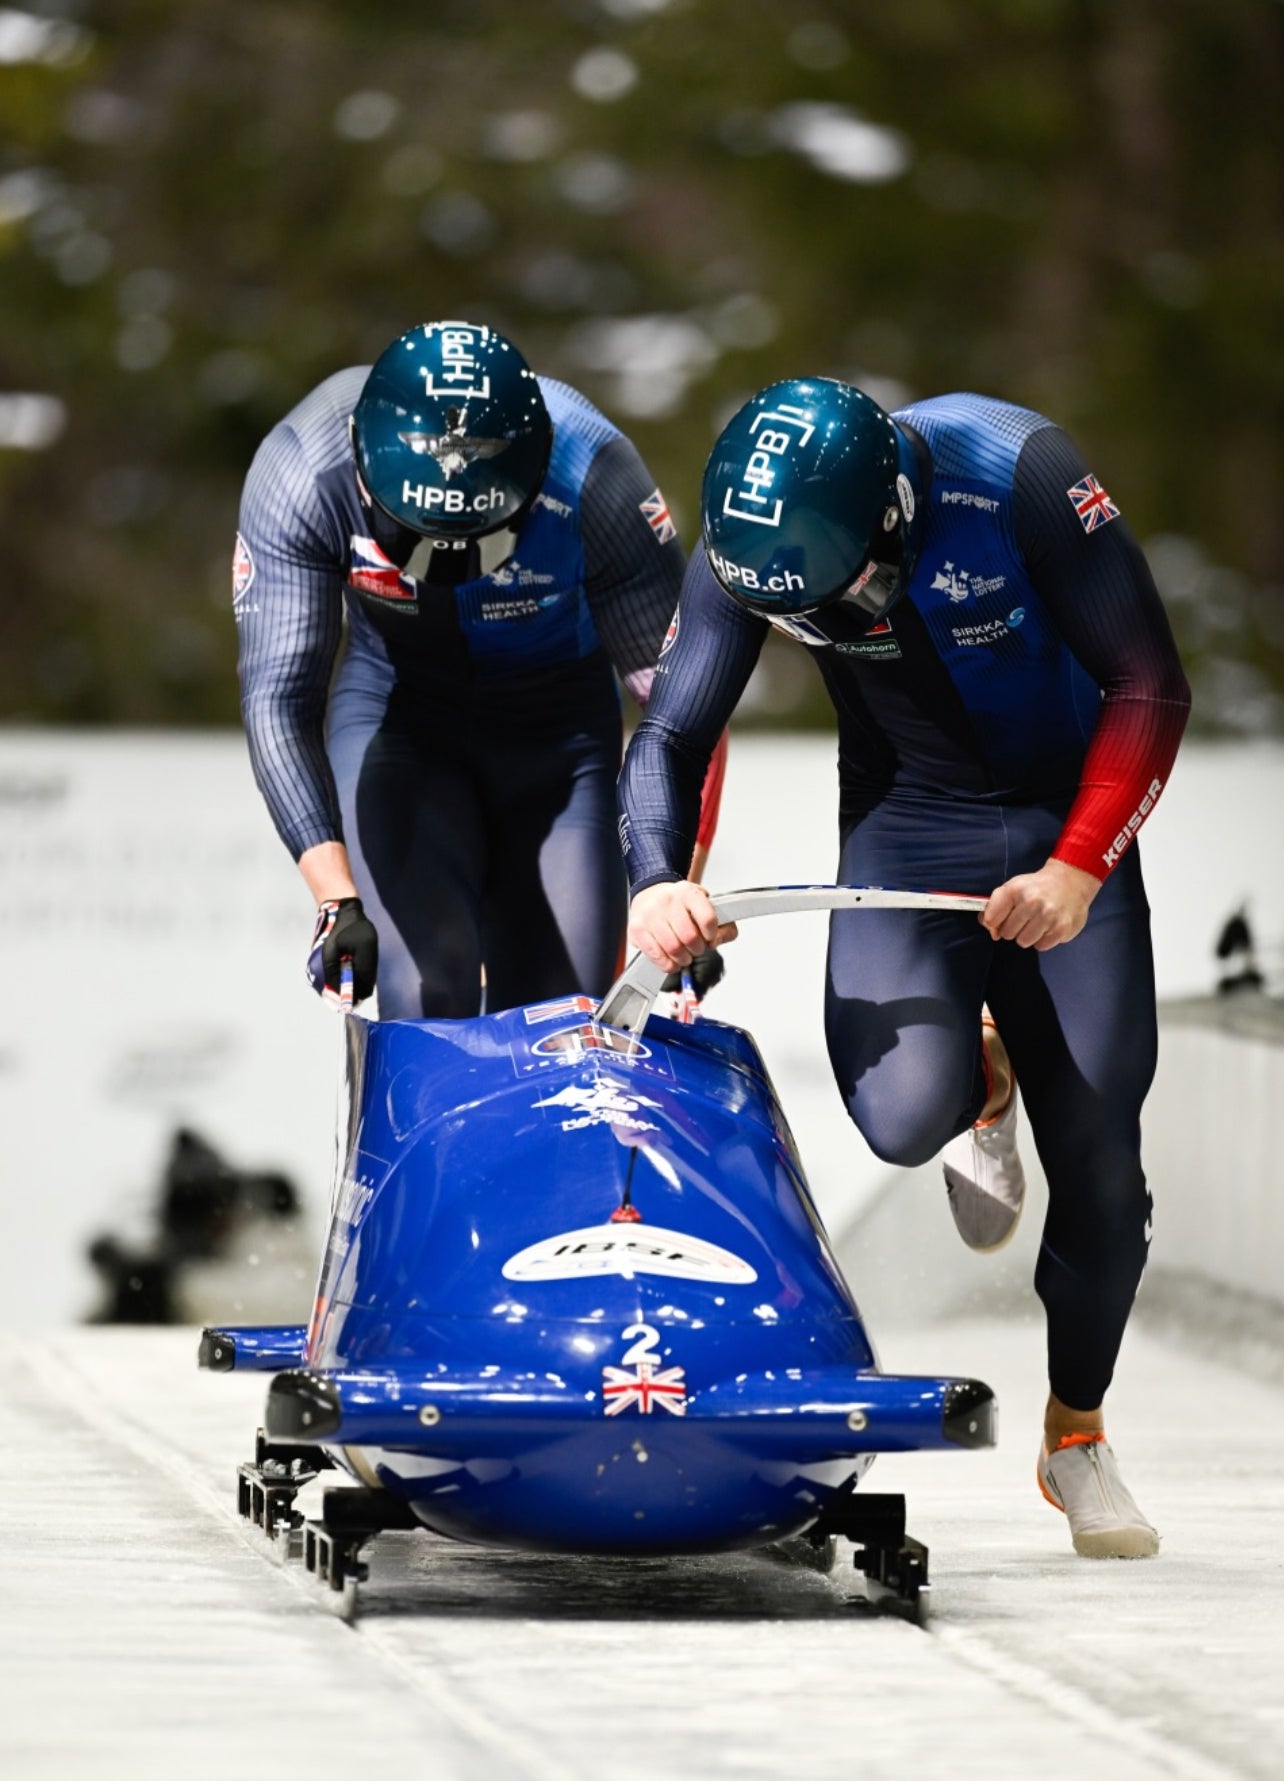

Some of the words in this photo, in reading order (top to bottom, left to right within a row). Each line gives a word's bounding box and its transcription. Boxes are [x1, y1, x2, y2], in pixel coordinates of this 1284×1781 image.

[402, 480, 505, 512] HPB.ch
[709, 548, 805, 592] HPB.ch
[481, 599, 536, 611] SIRKKA
[482, 605, 539, 621] HEALTH
[951, 619, 1004, 638] SIRKKA
[956, 627, 1009, 646] HEALTH
[1102, 778, 1162, 868] KEISER
[621, 1323, 661, 1366] 2
